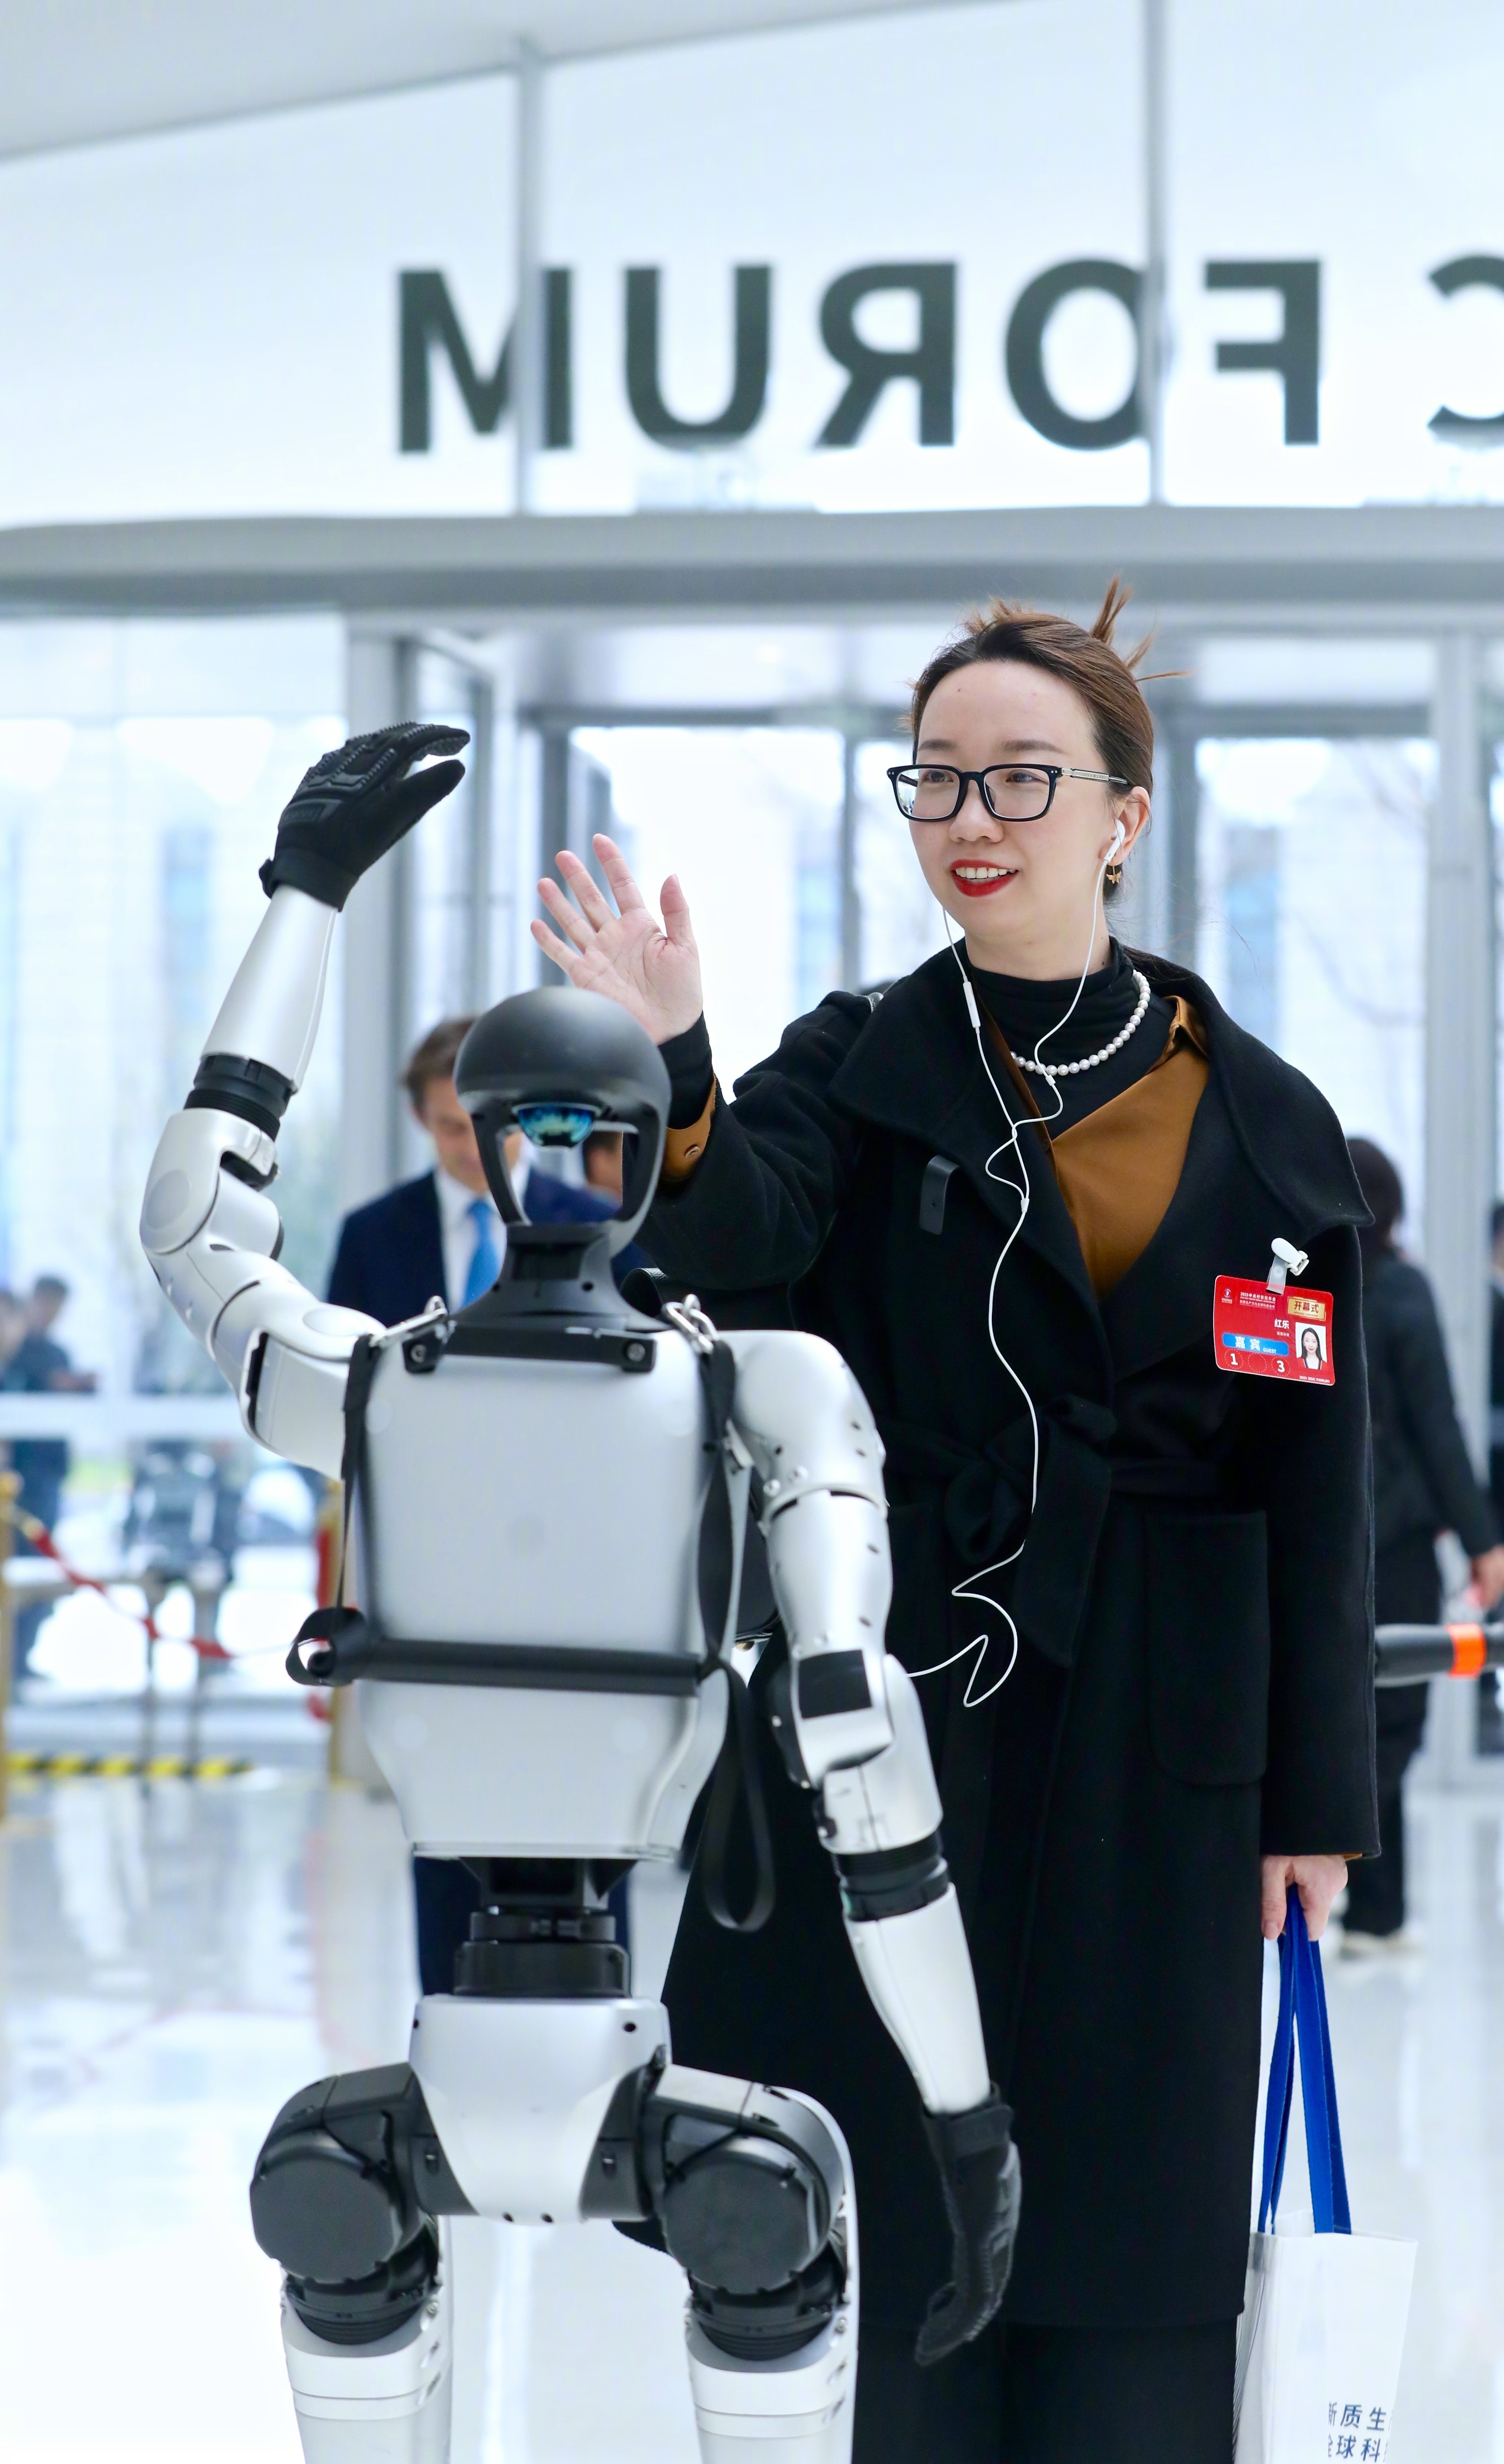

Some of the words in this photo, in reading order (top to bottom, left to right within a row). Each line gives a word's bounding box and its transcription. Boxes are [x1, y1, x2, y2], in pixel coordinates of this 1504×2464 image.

[1294, 1301, 1319, 1313] 开幕式
[1274, 1319, 1289, 1329] 红乐
[1235, 1336, 1260, 1351] 嘉宾
[1230, 1353, 1238, 1365] 1
[1276, 1360, 1285, 1373] 3
[1328, 2401, 1392, 2431] 新质生
[1328, 2433, 1388, 2462] 球科
